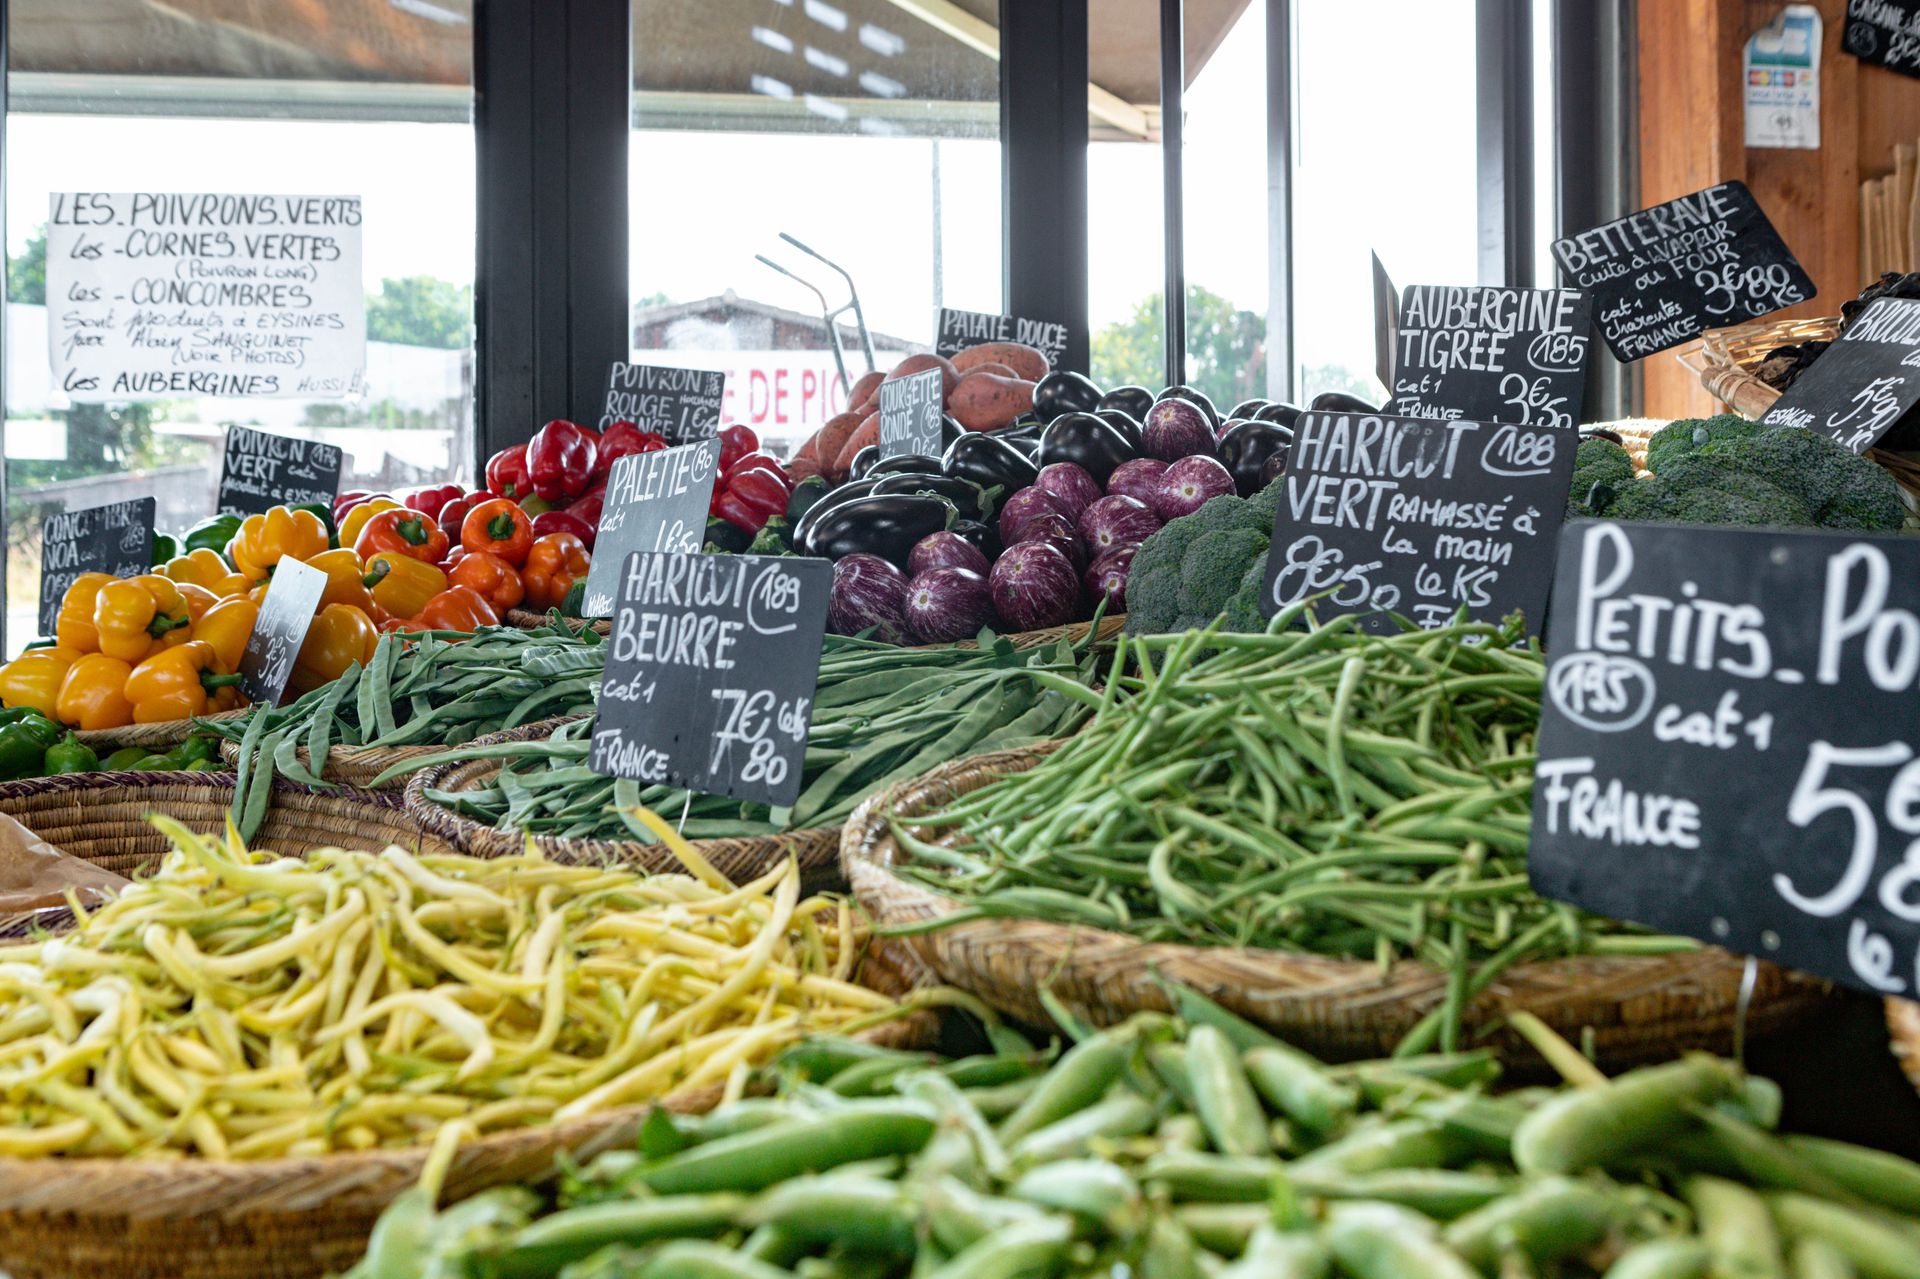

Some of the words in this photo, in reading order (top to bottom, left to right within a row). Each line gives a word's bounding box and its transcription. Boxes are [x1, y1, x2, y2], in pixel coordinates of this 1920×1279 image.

[286, 198, 363, 227] VERTS
[1555, 184, 1739, 273] BETTERAVE
[245, 234, 341, 262] VERTES
[1656, 220, 1736, 261] VAPEUR
[1635, 274, 1666, 290] ou
[1669, 242, 1741, 279] FOUR
[131, 277, 313, 308] CONCOMBRES
[1406, 285, 1582, 336] AUBERGINE
[191, 328, 312, 349] SANGUINET
[256, 312, 345, 330] EYSINES
[943, 309, 1012, 341] PATATE
[1017, 318, 1068, 350] DOUCE
[1618, 315, 1700, 358] FRANCE
[1532, 334, 1589, 366] 185
[113, 371, 280, 396] AUBERGINES
[610, 361, 702, 393] POIVRON
[881, 369, 941, 415] COURGETTE
[605, 389, 675, 419] ROUGE
[750, 368, 789, 424] DE
[881, 411, 913, 445] RONDE
[1497, 432, 1556, 465] 188
[226, 453, 282, 482] VERT
[610, 443, 698, 507] PALETTE
[1288, 474, 1399, 532] VERT
[1513, 505, 1541, 536] à
[43, 540, 79, 572] NOA
[1434, 533, 1513, 565] main
[759, 571, 801, 614] 189
[613, 607, 745, 669] BEURRE
[595, 728, 671, 781] FRANCE
[1536, 756, 1701, 849] FRANCE
